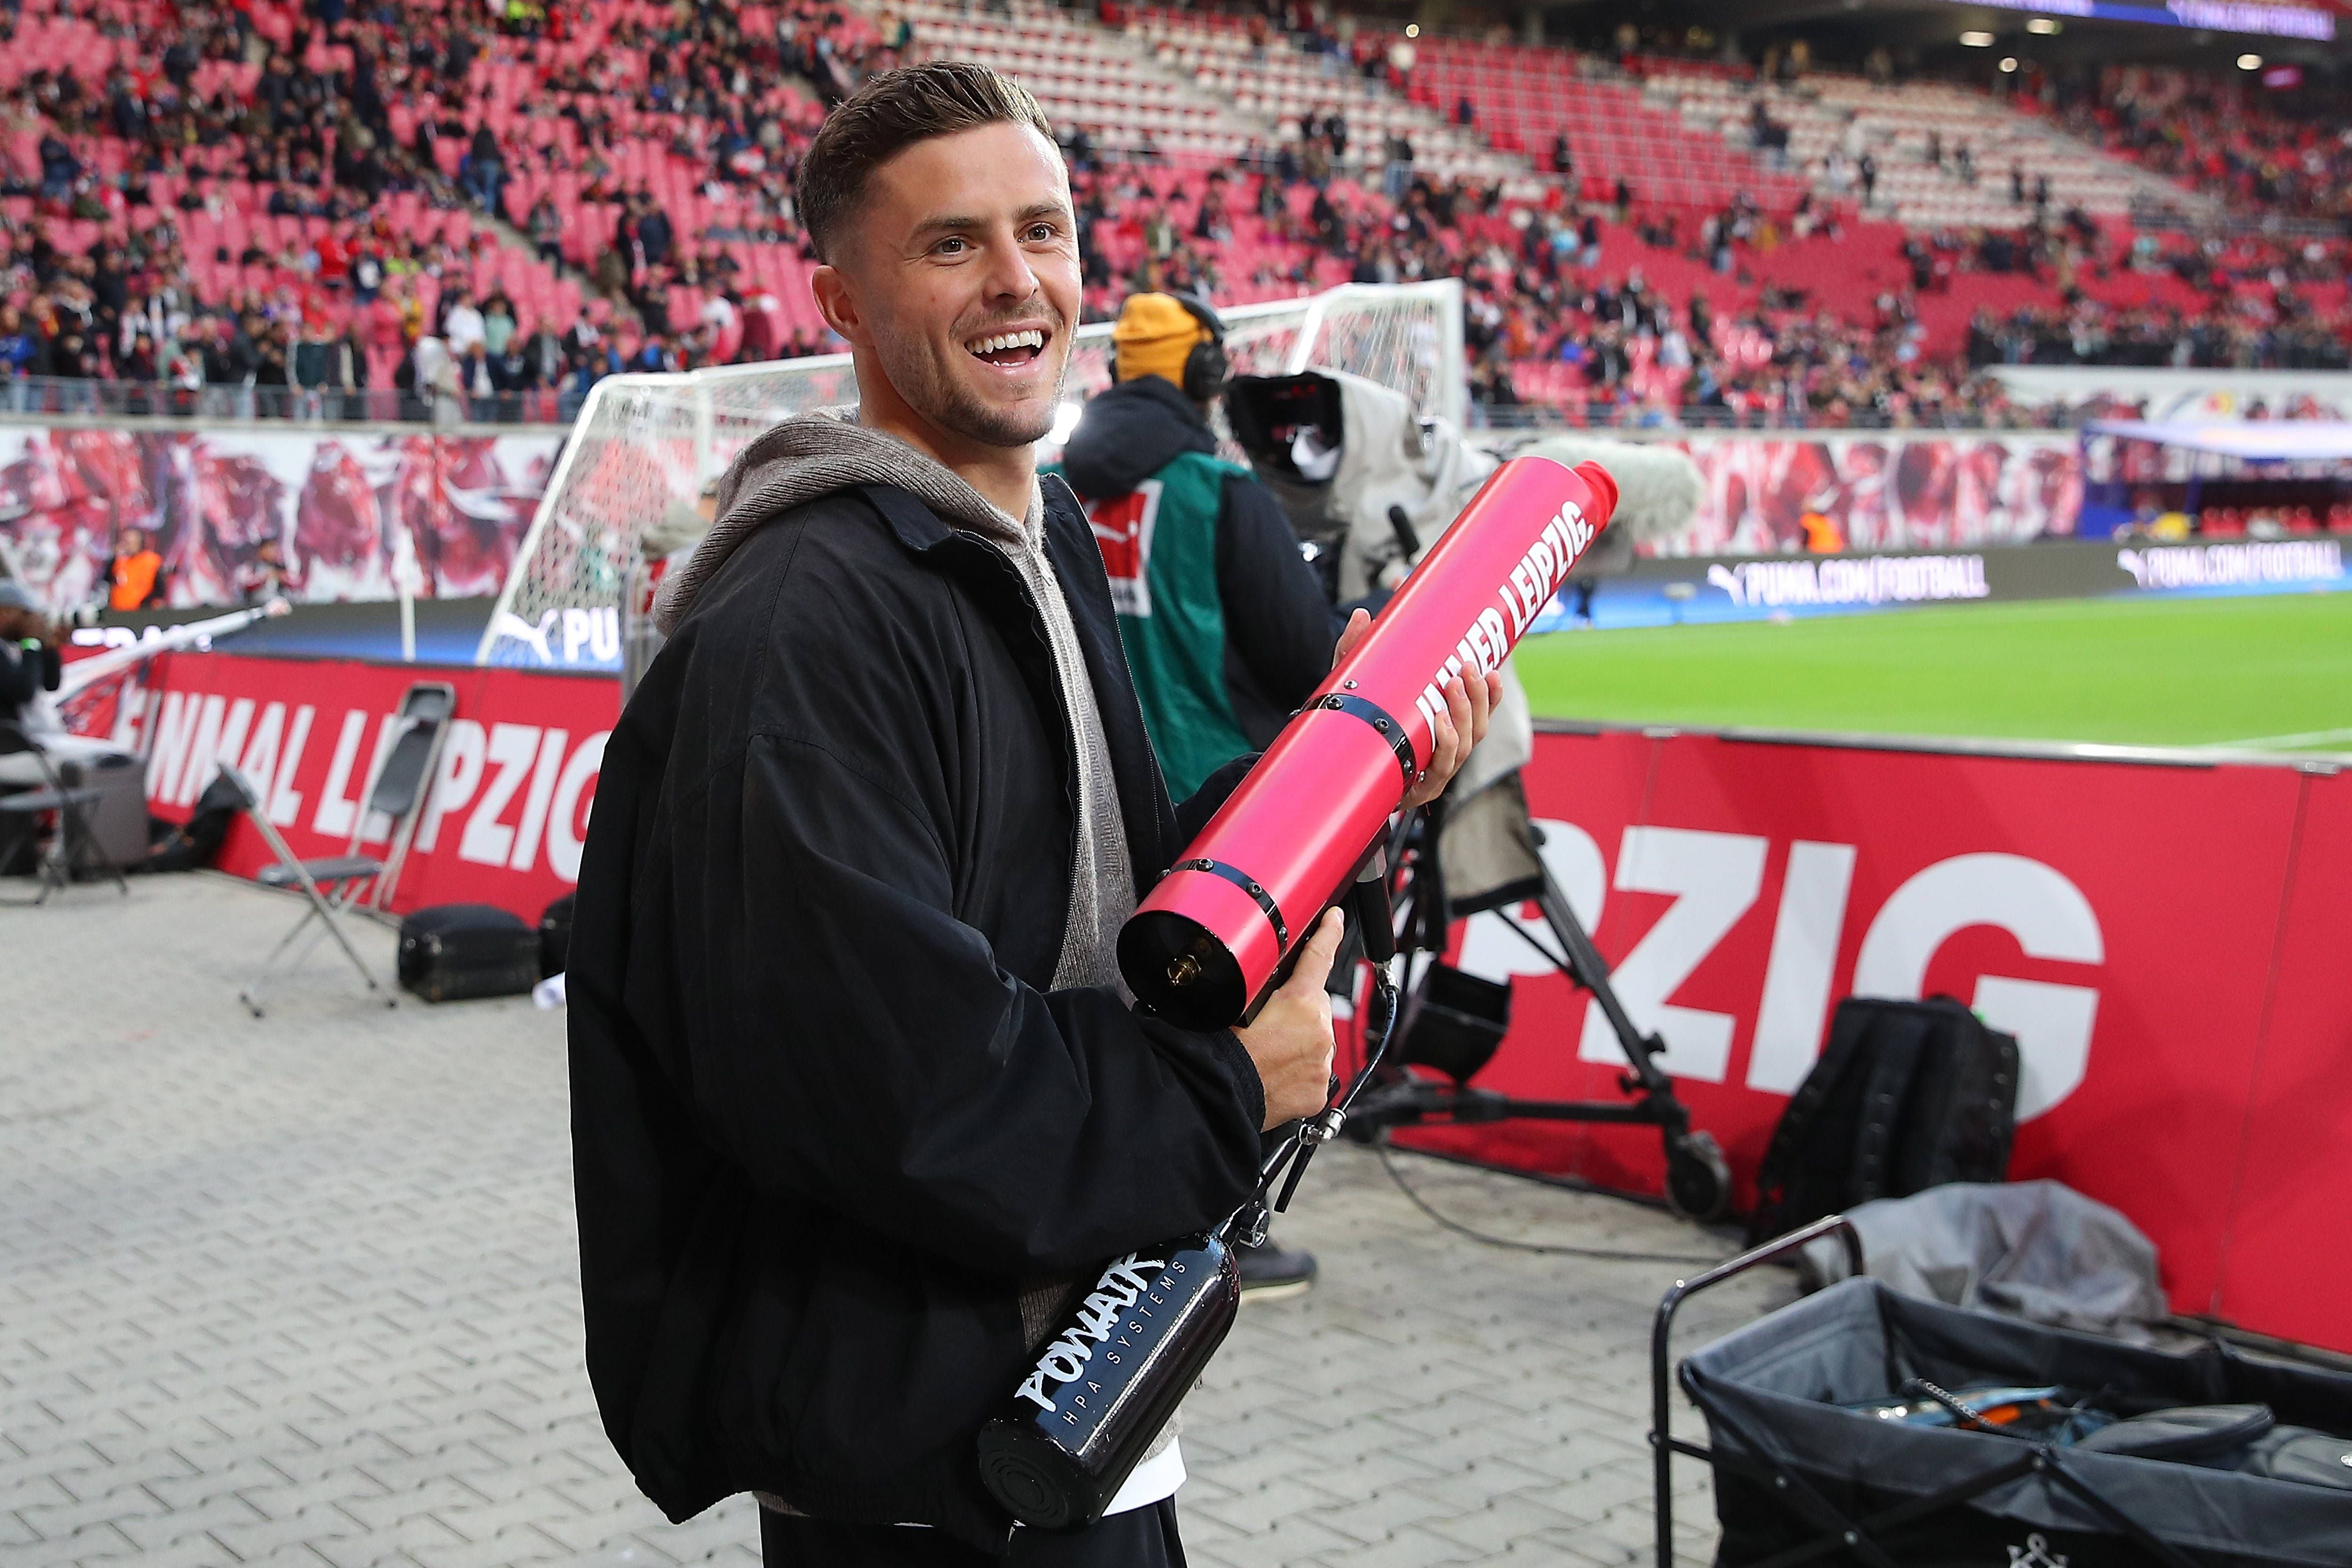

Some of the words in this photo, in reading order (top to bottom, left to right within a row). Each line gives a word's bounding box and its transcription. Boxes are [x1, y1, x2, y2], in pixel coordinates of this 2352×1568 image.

[1498, 500, 1596, 639] LEIPZIG.
[1061, 1380, 1102, 1426] HPA
[1105, 1260, 1186, 1365] SYSTEMS
